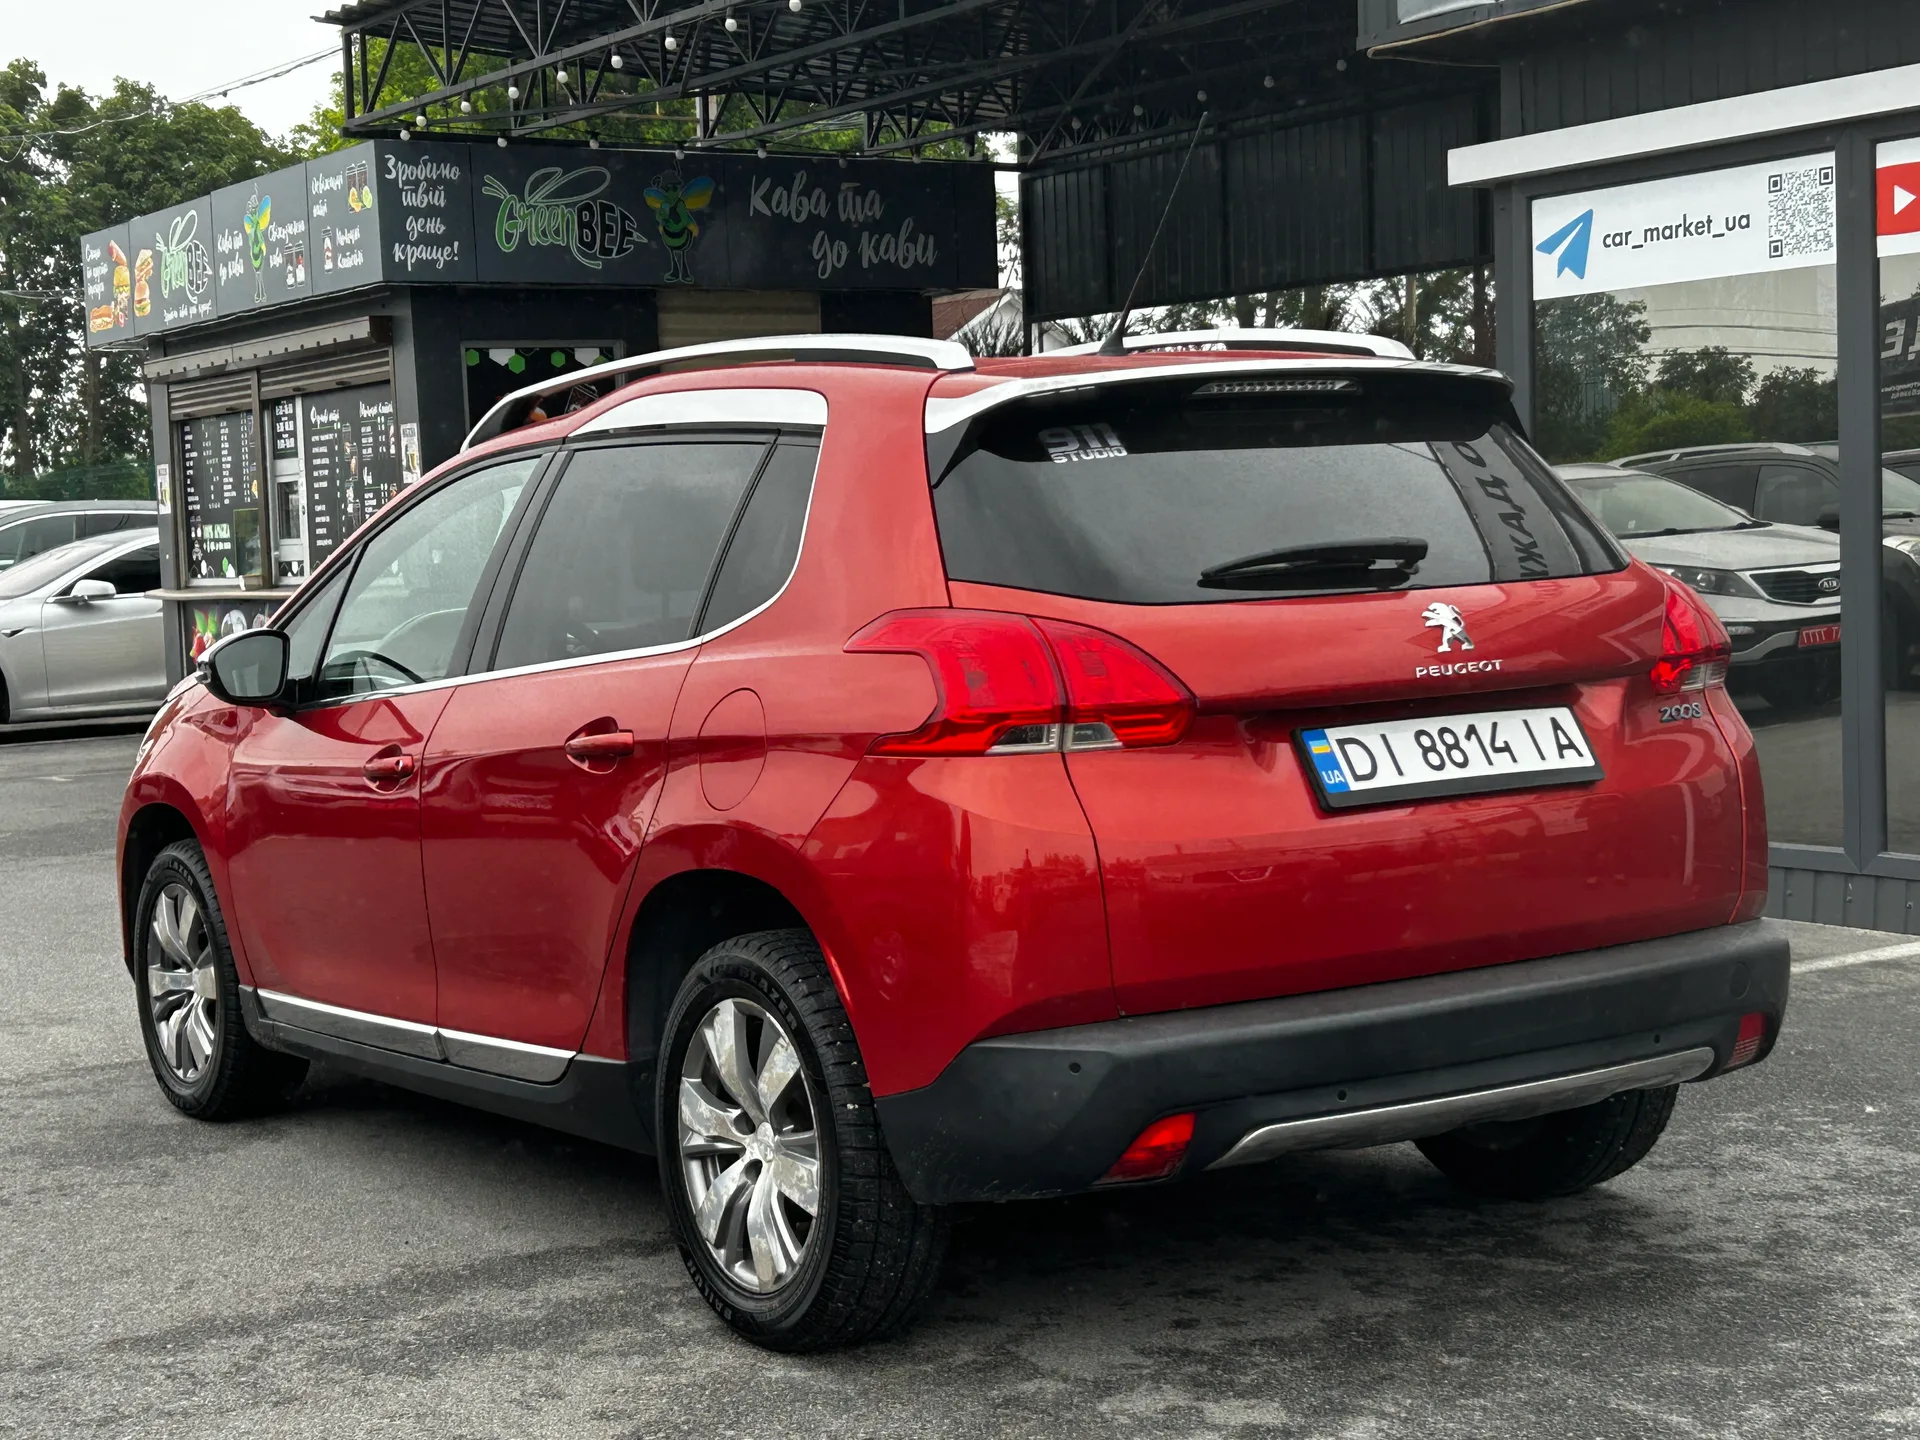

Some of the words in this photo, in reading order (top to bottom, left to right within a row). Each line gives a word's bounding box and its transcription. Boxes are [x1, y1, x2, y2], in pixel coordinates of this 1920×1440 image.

[385, 154, 460, 188] Зробимо
[402, 182, 446, 207] твій
[750, 170, 831, 223] Кава
[838, 183, 885, 222] та
[406, 215, 446, 241] день
[1602, 213, 1750, 250] car_market_ua
[393, 241, 459, 271] краще!
[812, 230, 849, 279] до
[858, 217, 939, 269] кави
[1038, 422, 1121, 453] 911
[1415, 660, 1503, 678] PEUGEOT
[1659, 702, 1703, 723] 2008
[1335, 733, 1404, 782] DI
[1414, 721, 1518, 772] 8814
[1522, 716, 1584, 760] IA
[1322, 770, 1345, 786] UA
